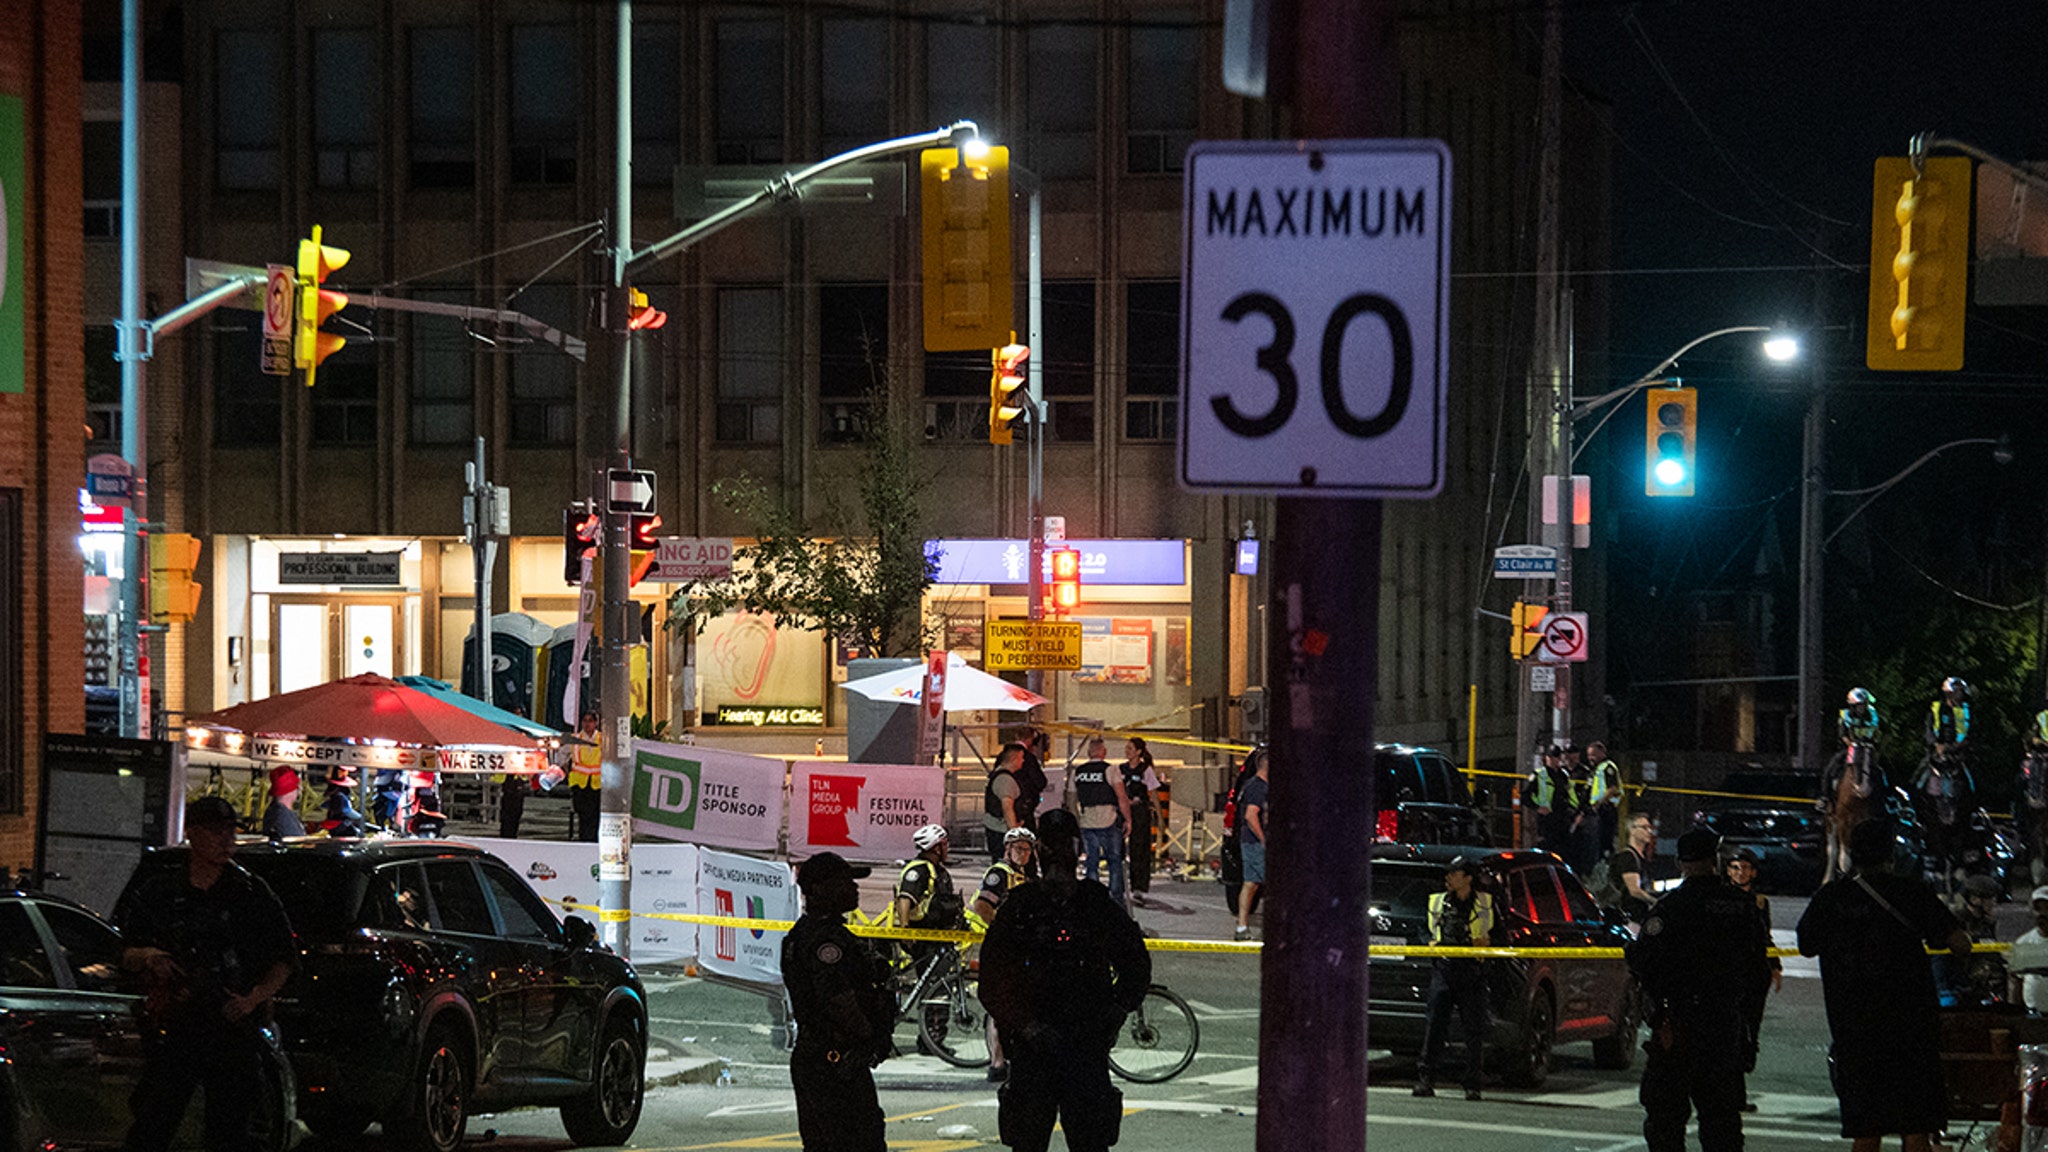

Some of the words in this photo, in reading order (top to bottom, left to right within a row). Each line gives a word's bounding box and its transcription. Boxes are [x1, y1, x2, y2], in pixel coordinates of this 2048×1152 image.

[1208, 188, 1425, 238] MAXIMUM
[1210, 291, 1413, 440] 30
[655, 544, 690, 561] ING
[696, 545, 729, 561] AID
[284, 562, 353, 576] PROFESSIONAL
[356, 562, 397, 576] BUILDING
[1499, 559, 1509, 570] St
[1510, 559, 1533, 570] Clair
[990, 625, 1033, 638] TURNING
[1037, 626, 1079, 638] TRAFFIC
[1002, 640, 1030, 651] MUST
[1036, 640, 1066, 652] YIELD
[990, 653, 1004, 665] TO
[1008, 653, 1078, 666] PEDESTRIANS
[720, 708, 765, 726] Hearing
[766, 709, 789, 723] Aid
[789, 709, 824, 723] Clinic
[254, 743, 279, 756] WE
[440, 750, 485, 769] WATER
[489, 755, 505, 769] $2
[641, 763, 692, 813] TD
[704, 783, 739, 799] TITLE
[812, 780, 831, 790] TLN
[812, 791, 841, 803] MEDIA
[702, 798, 767, 817] SPONSOR
[812, 804, 842, 815] GROUP
[869, 798, 926, 812] FESTIVAL
[869, 813, 929, 827] FOUNDER
[727, 869, 747, 883] MEDIA
[747, 871, 783, 888] PARTNERS
